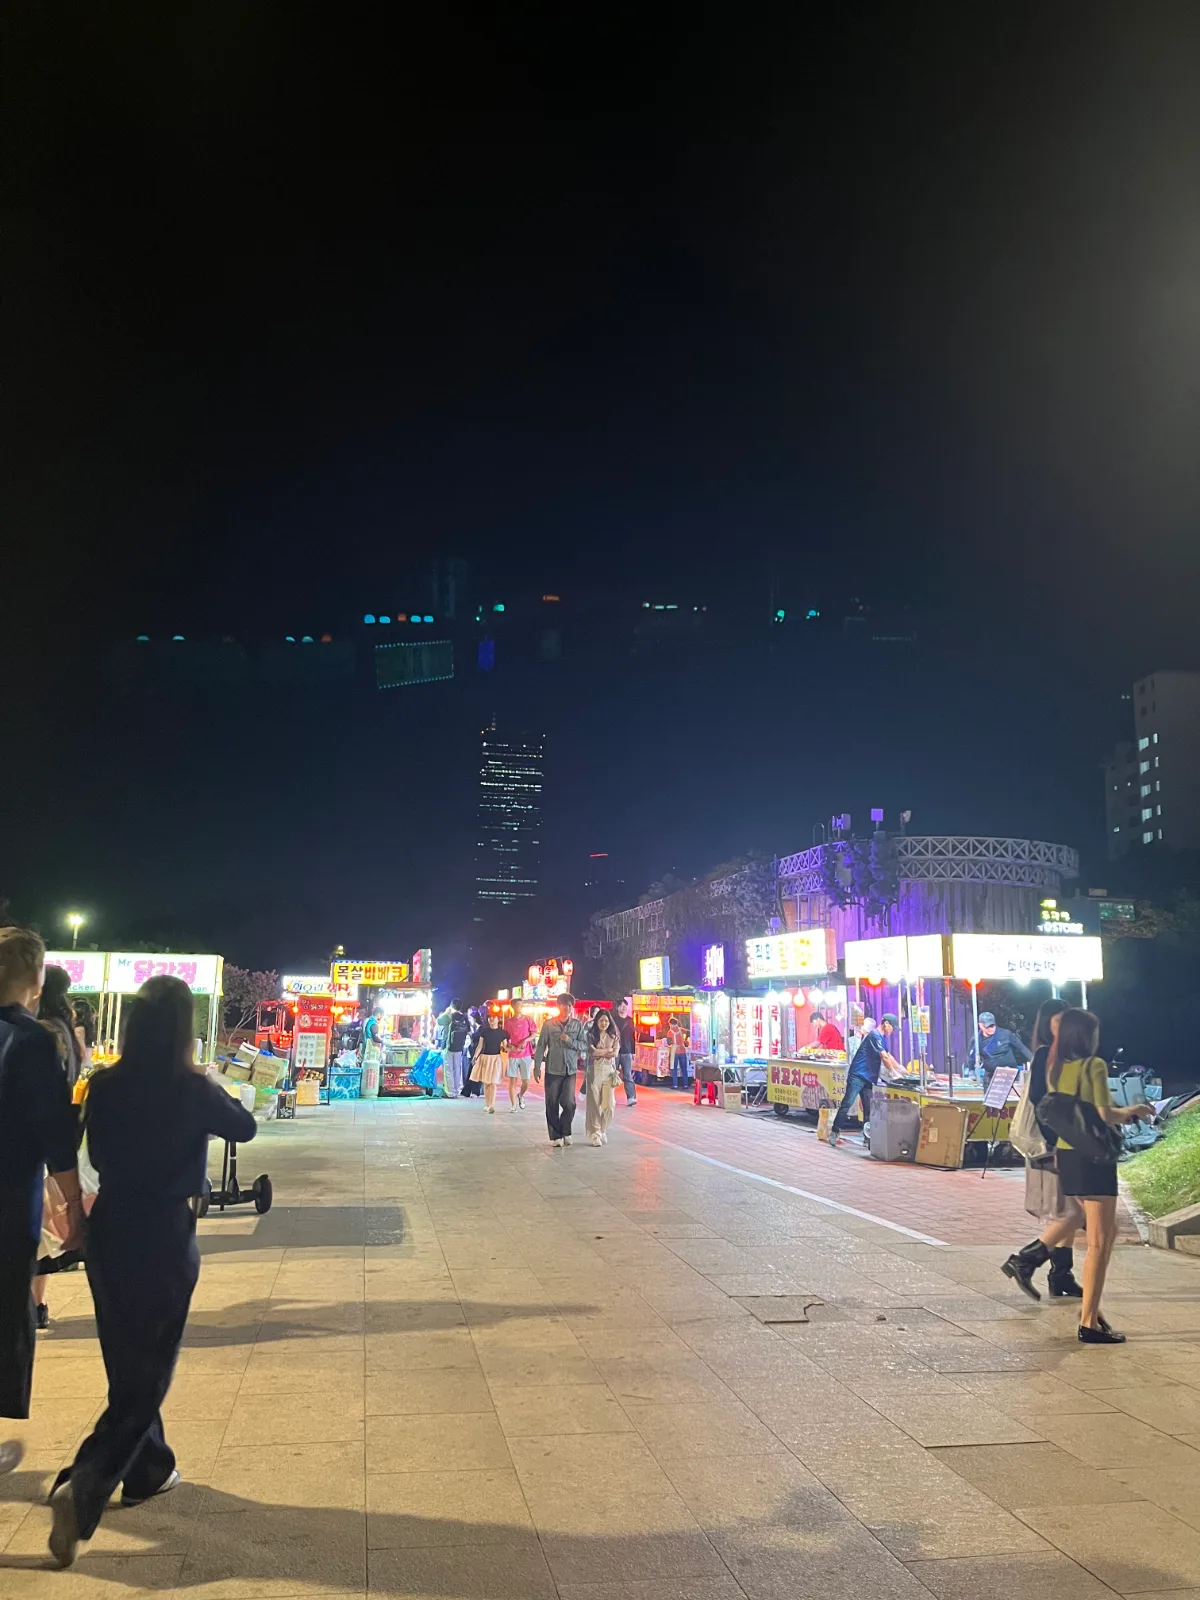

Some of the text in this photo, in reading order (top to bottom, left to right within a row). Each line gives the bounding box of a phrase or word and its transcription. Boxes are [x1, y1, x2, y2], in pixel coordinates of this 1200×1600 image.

[118, 959, 131, 967] Mr
[751, 1004, 763, 1055] 바베큐
[771, 1066, 801, 1087] 닭꼬치
